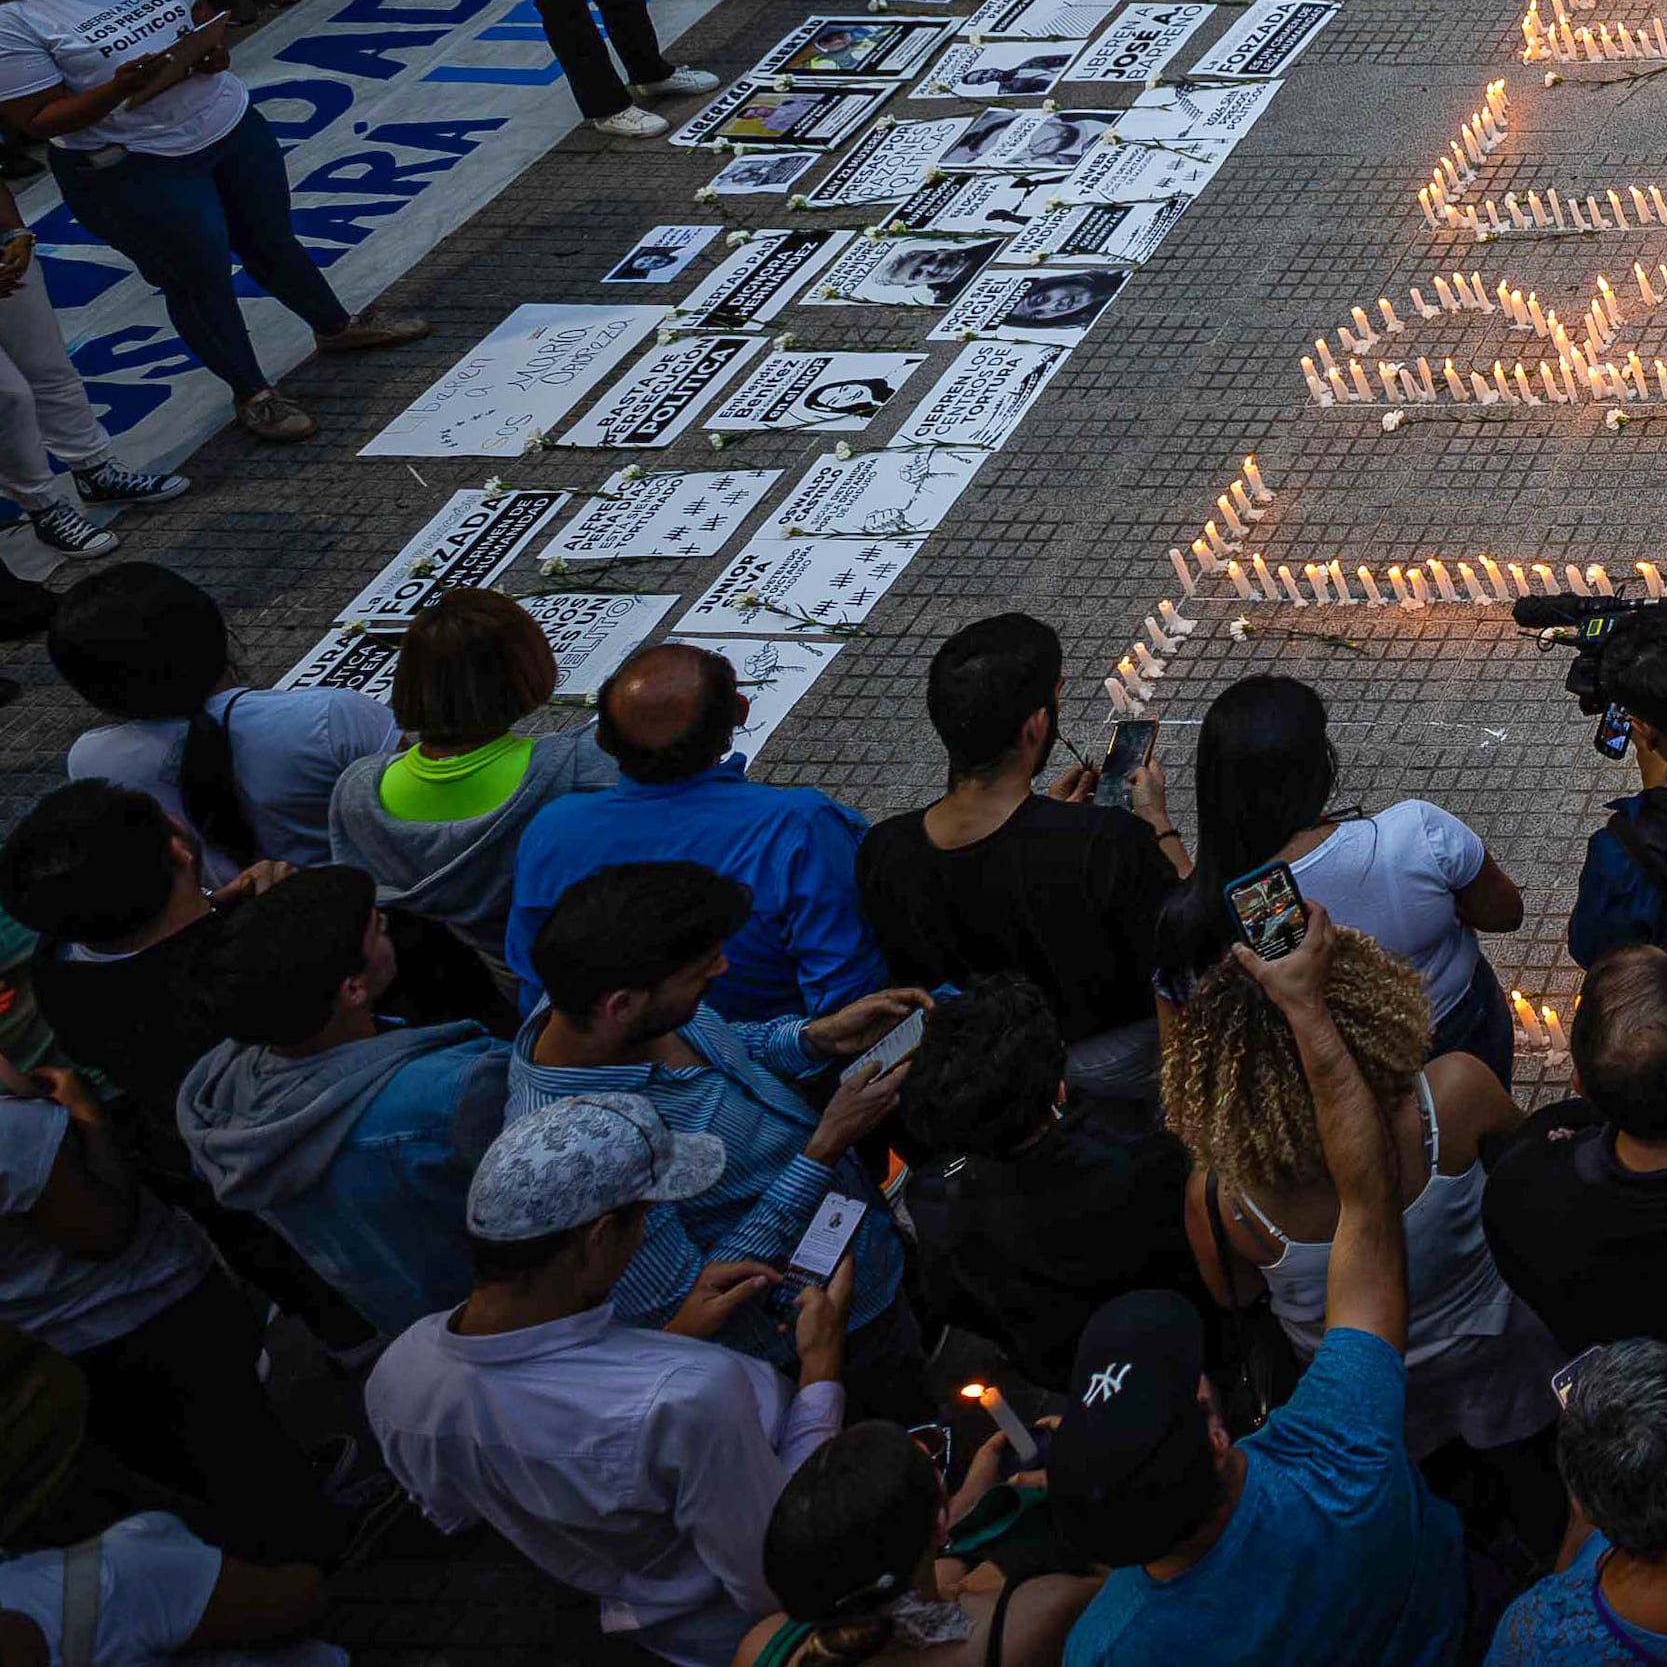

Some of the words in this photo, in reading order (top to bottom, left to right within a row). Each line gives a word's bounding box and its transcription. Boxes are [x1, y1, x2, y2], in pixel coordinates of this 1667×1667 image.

[74, 10, 116, 34] LIBEREN
[85, 25, 118, 44] LOS
[100, 5, 187, 59] POLÍTICOS
[758, 19, 825, 74] LIBERTAD
[1074, 21, 1142, 78] LIBEREN
[1131, 7, 1155, 16] A
[1093, 30, 1163, 78] JOSÉ
[1146, 6, 1184, 24] A.
[1124, 5, 1205, 78] BARRENO
[1214, 3, 1296, 72] FORZADA
[682, 80, 753, 141] LIBERTAD
[833, 154, 892, 199] PRESAS
[879, 126, 915, 150] POR
[851, 126, 939, 195] RAZONES
[871, 123, 963, 197] POLÍTICAS
[1072, 152, 1111, 185] JAVIER
[1077, 143, 1131, 195] TARAZONA
[1006, 208, 1058, 252] NICOLÁS
[1023, 207, 1074, 253] MADURO
[679, 267, 753, 326] LIBERTAD
[725, 250, 793, 306] DIGNORA
[730, 241, 821, 315] HERNÁNDEZ
[936, 301, 976, 331] ROCÍO
[967, 278, 995, 298] SAN
[953, 277, 1013, 330] MIGUEL
[986, 281, 1036, 325] MADURO
[594, 376, 658, 426] BASTA
[647, 353, 681, 373] DE
[597, 338, 716, 443] PERSECUCIÓN
[630, 347, 738, 433] POLÍTICA
[909, 375, 974, 436] CIERREN
[962, 347, 997, 371] LOS
[930, 370, 997, 434] CENTROS
[984, 348, 1014, 366] DE
[956, 357, 1025, 423] TORTURA
[473, 412, 537, 450] SOS
[775, 466, 835, 524] OSWALDO
[790, 469, 846, 522] CASTILLO
[812, 516, 833, 531] POR
[827, 504, 843, 513] LA
[835, 457, 882, 502] DICTADURA
[827, 461, 868, 500] DETENIDO
[844, 470, 880, 506] MADURO
[466, 497, 556, 573] HUMANIDAD
[574, 516, 621, 549] PEÑA
[595, 523, 631, 548] ESTÁ
[623, 477, 672, 519] SIENDO
[611, 478, 687, 548] TORTURADO
[372, 495, 514, 613] FORZADA
[438, 569, 469, 588] UN
[457, 520, 516, 566] CRIMEN
[505, 499, 534, 515] DE
[759, 548, 803, 590] DETENIDO
[356, 596, 384, 612] La
[693, 554, 760, 613] JUNIOR
[719, 560, 773, 607] SILVA
[740, 607, 763, 624] POR
[766, 545, 815, 593] DICTADURA
[774, 559, 814, 597] MADURO
[573, 597, 612, 624] UN
[537, 597, 640, 687] DELITO
